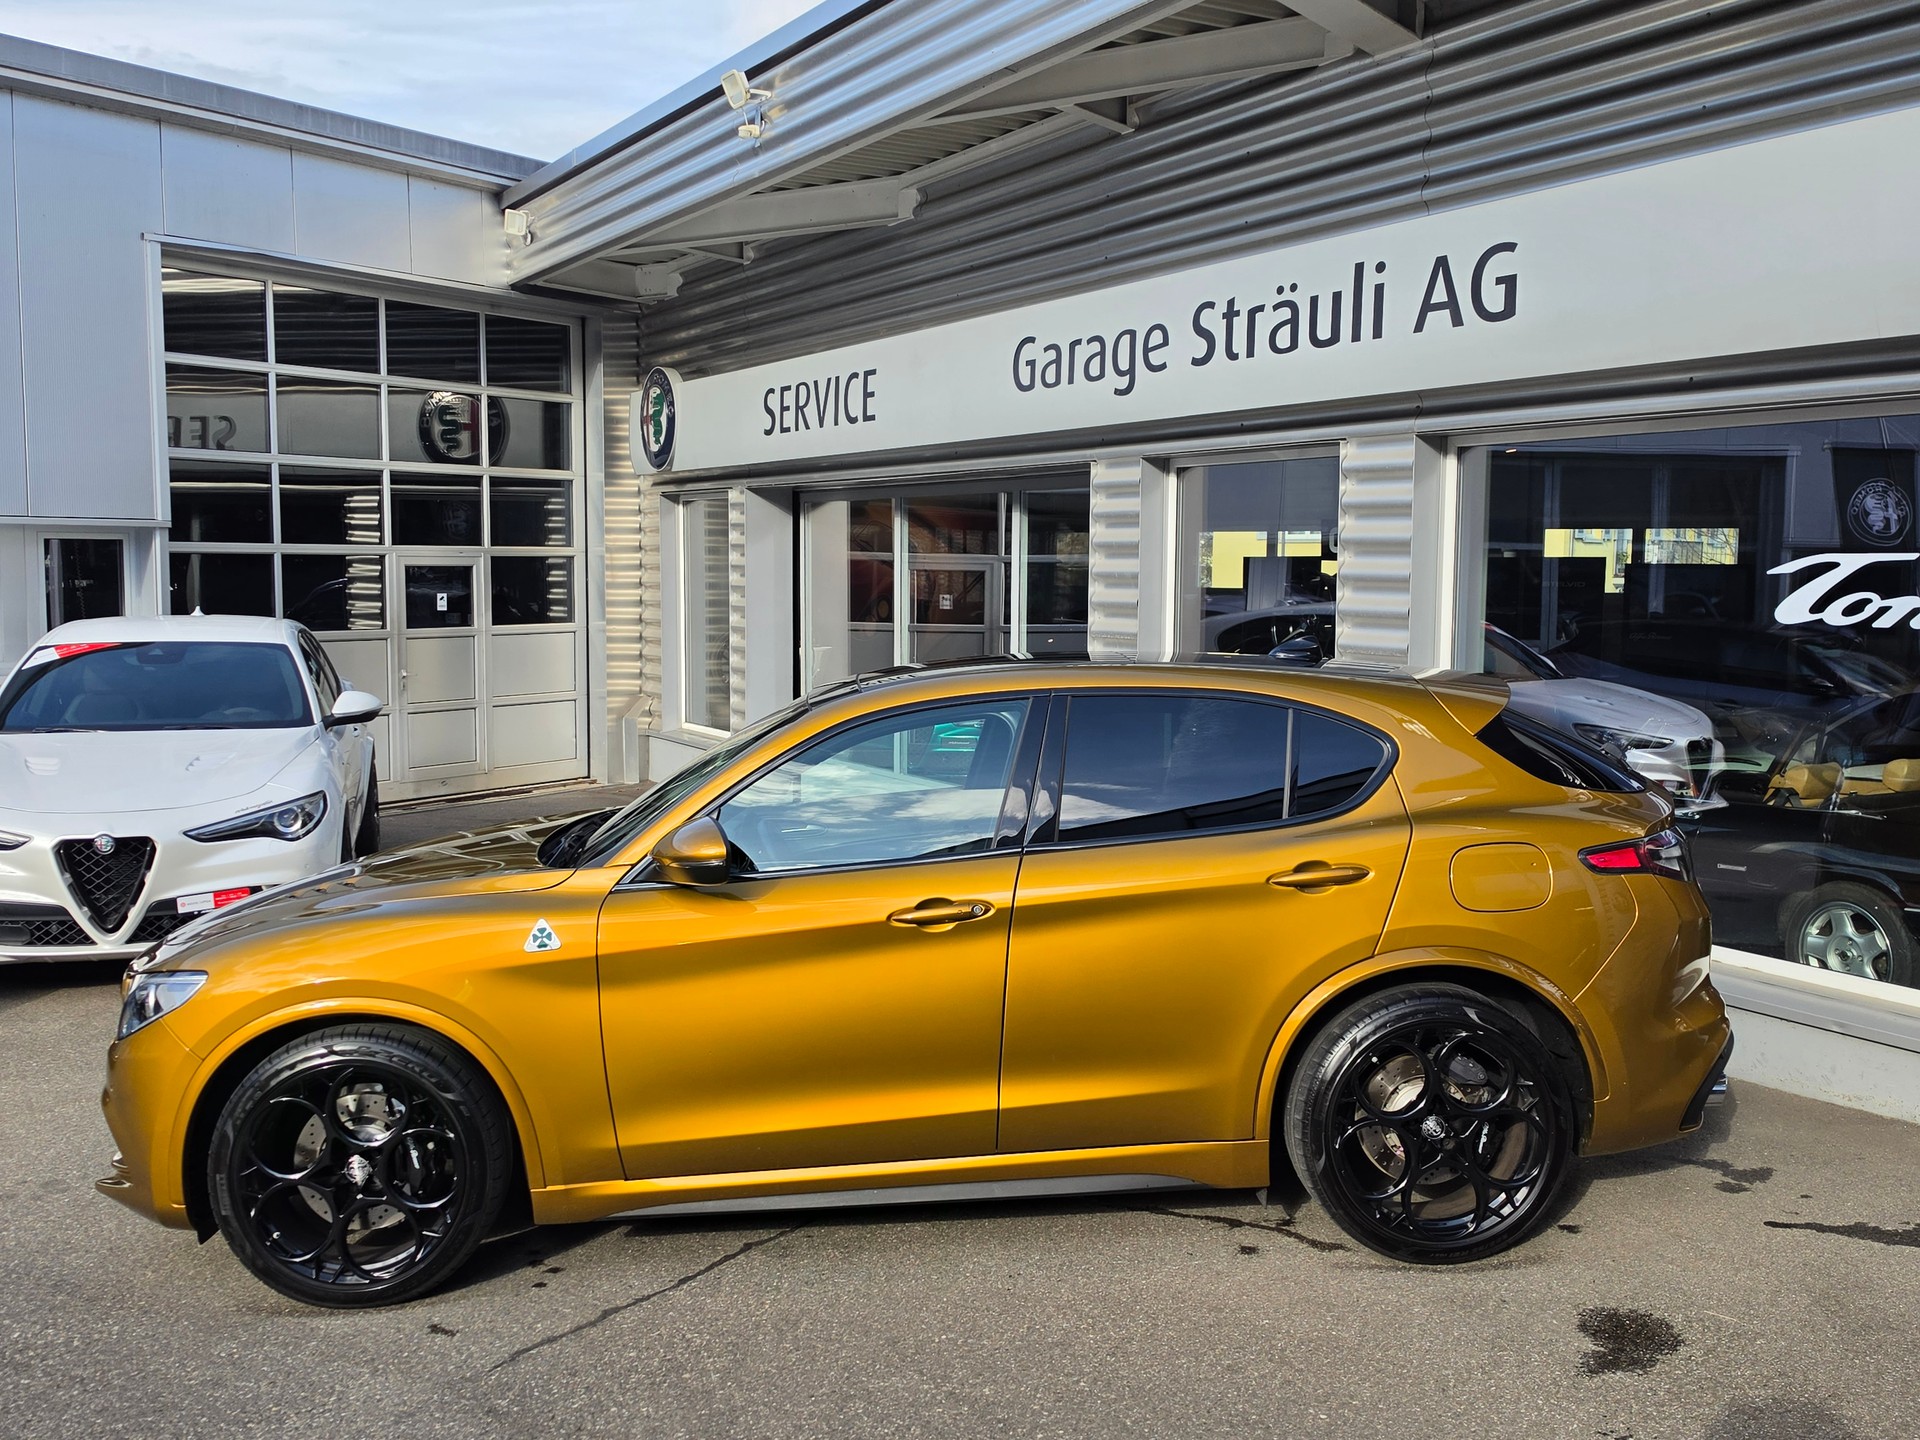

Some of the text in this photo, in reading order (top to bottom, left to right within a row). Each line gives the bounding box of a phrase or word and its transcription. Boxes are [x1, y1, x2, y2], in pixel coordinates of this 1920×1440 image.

[1013, 241, 1518, 396] Garage Sträuli AG
[763, 368, 877, 436] SERVICE
